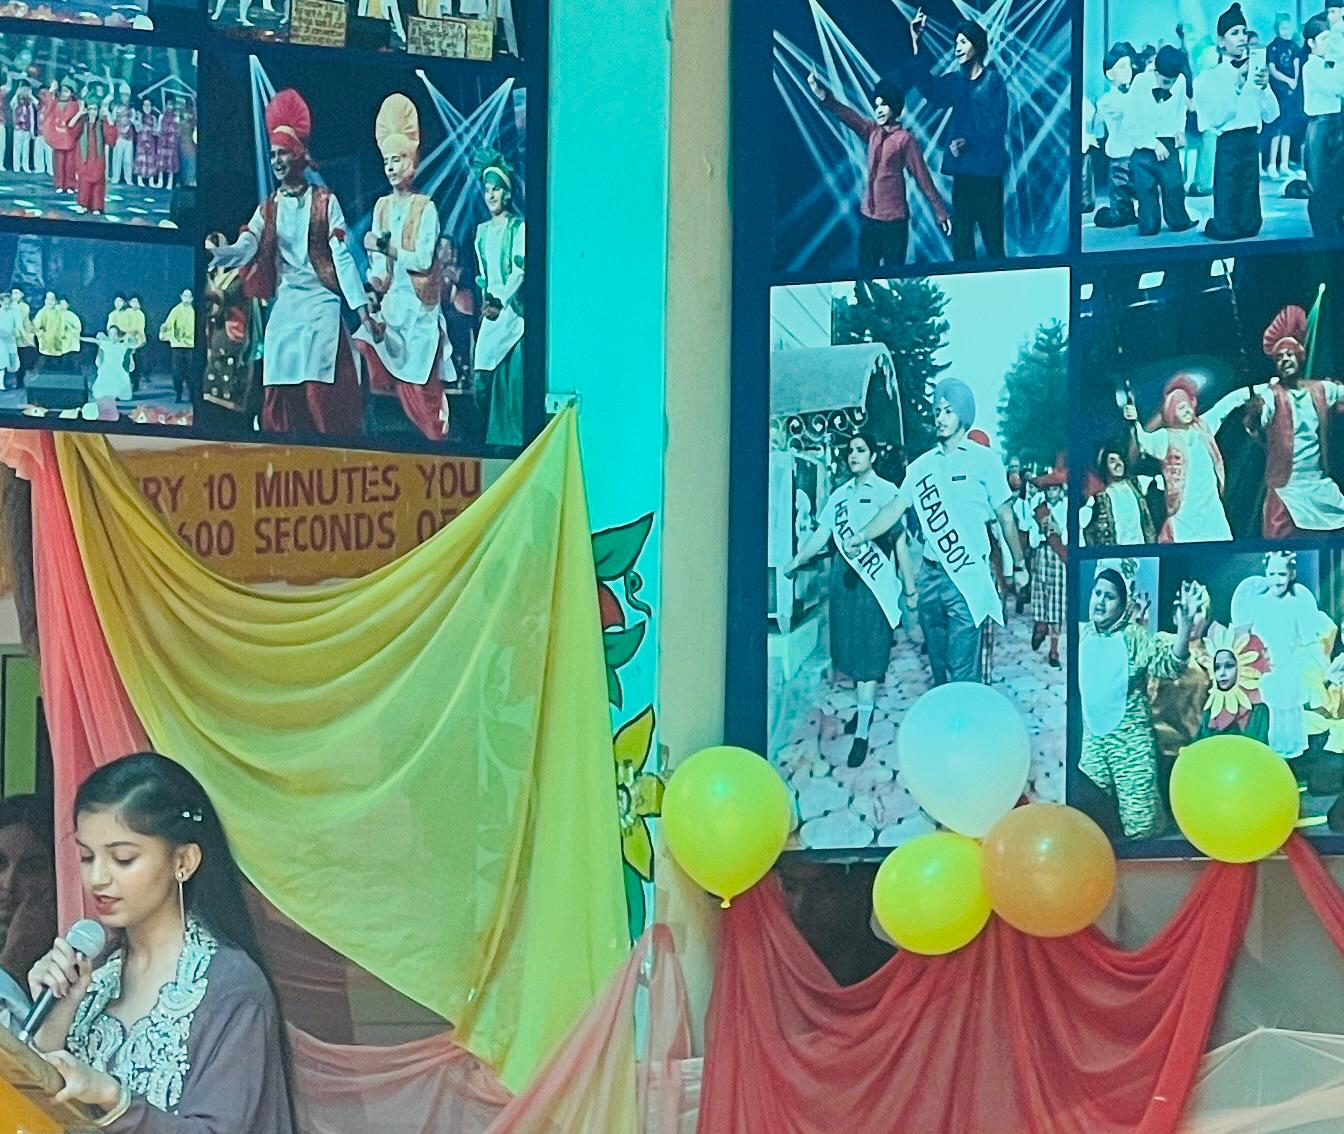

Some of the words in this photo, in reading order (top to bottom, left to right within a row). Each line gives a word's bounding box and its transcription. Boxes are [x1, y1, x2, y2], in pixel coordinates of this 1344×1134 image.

[135, 473, 186, 514] RY
[203, 472, 237, 513] 10
[256, 464, 401, 509] MINUTES
[415, 460, 482, 500] YOU
[254, 510, 396, 555] SECONDS
[916, 473, 949, 533] HEAD
[937, 528, 975, 573] BOY
